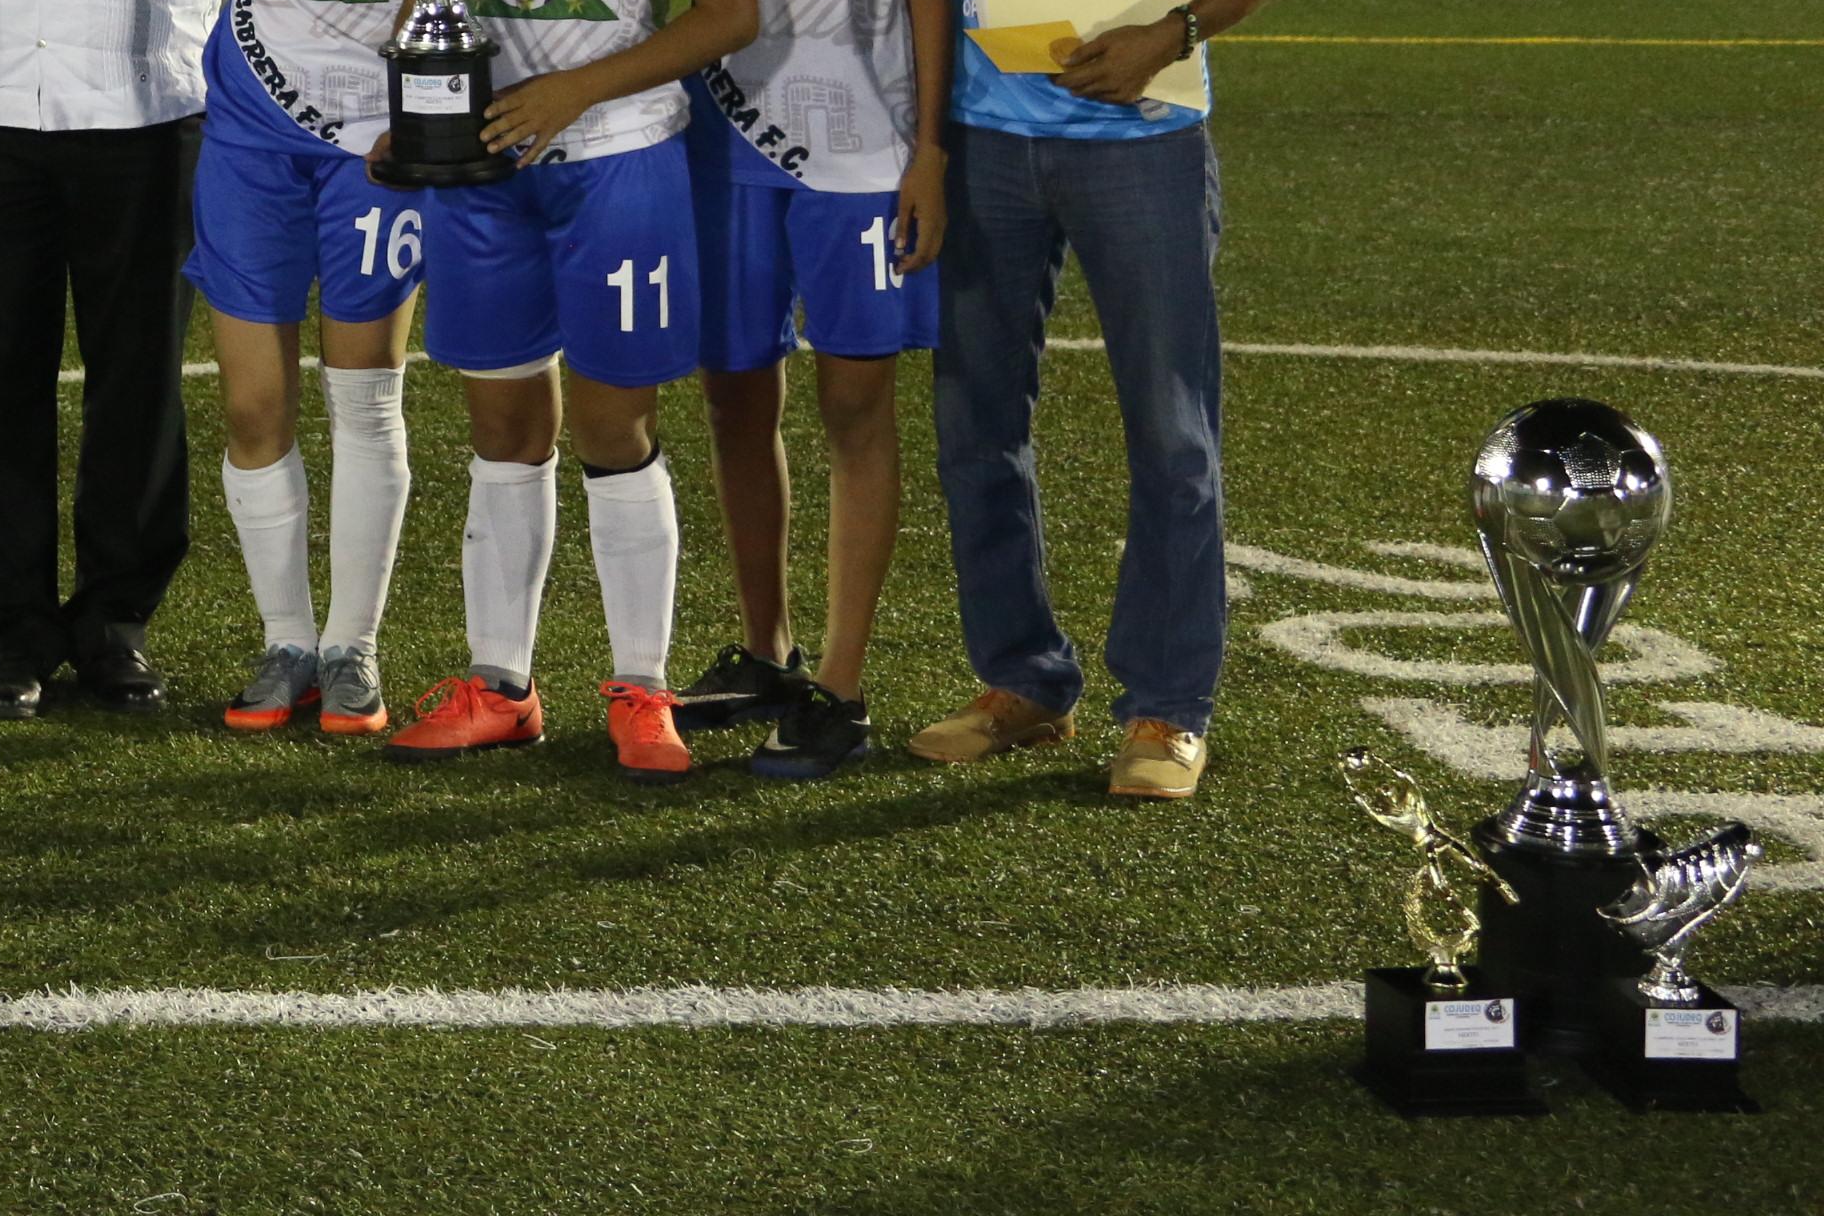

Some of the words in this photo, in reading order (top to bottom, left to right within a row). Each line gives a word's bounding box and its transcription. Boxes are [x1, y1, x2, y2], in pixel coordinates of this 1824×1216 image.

[296, 105, 344, 144] F.C.
[755, 124, 810, 178] F.C.
[354, 207, 422, 280] 16
[607, 255, 669, 331] 11
